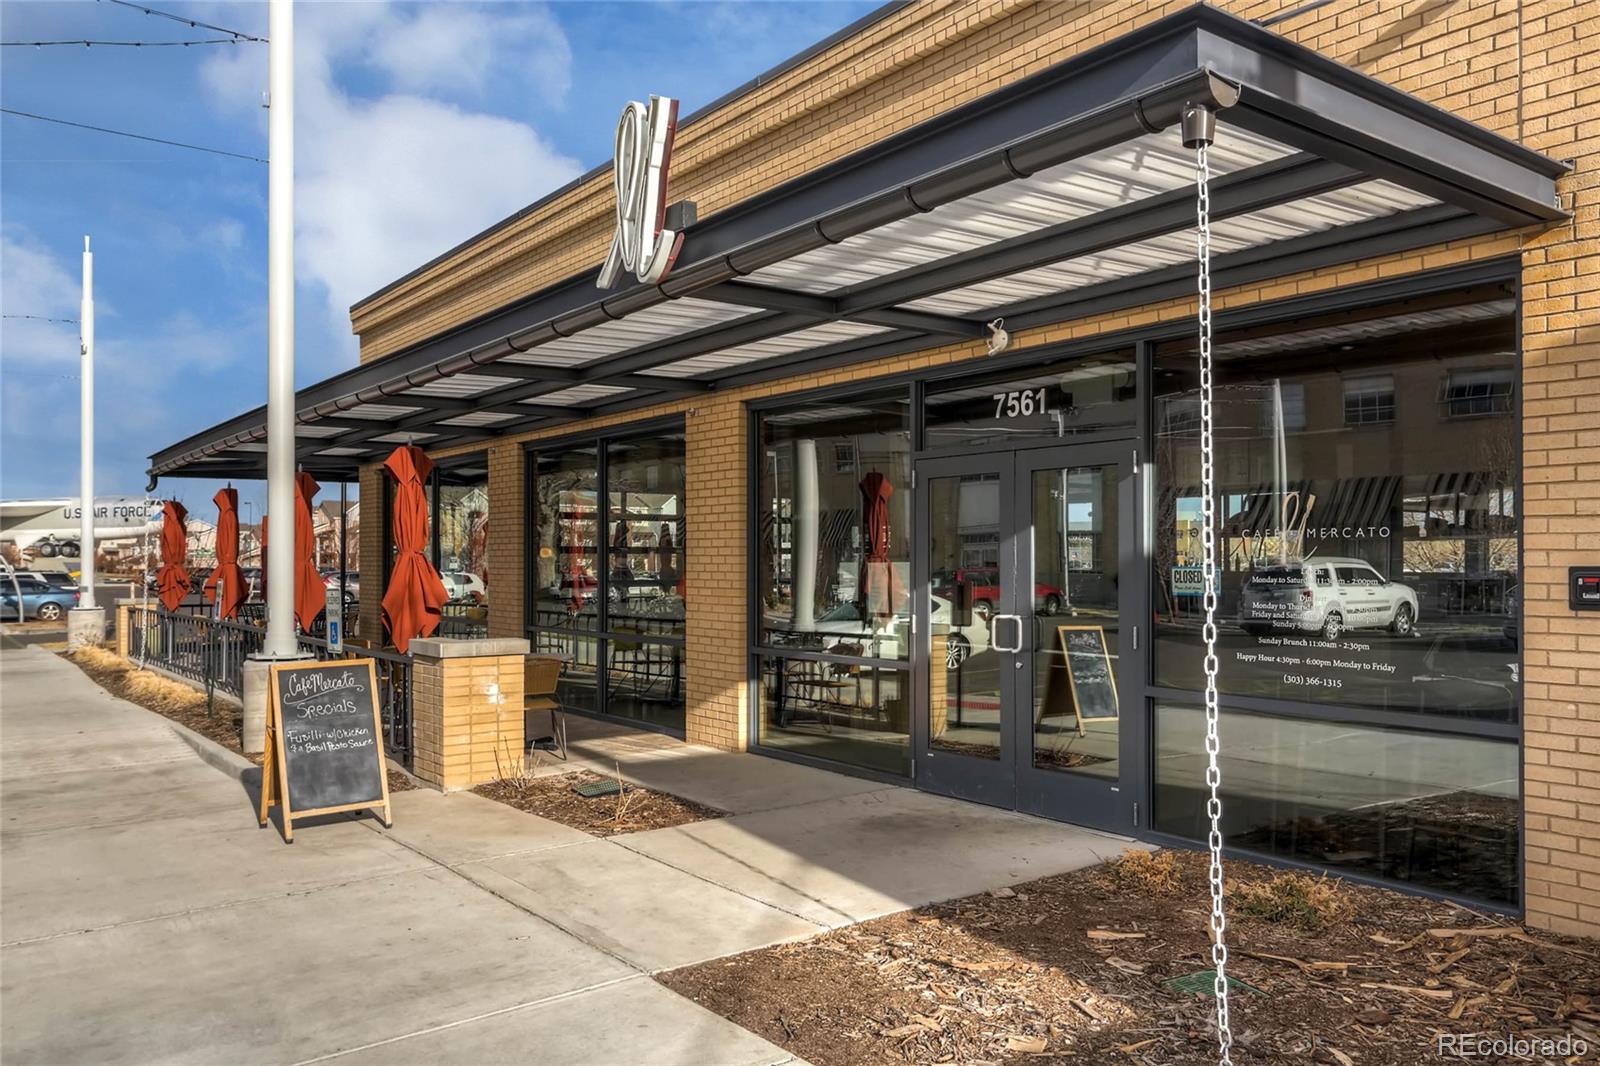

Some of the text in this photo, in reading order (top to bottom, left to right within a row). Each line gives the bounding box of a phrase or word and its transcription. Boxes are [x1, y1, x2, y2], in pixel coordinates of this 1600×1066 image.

[993, 388, 1045, 419] 7561
[64, 508, 82, 519] U.S
[113, 505, 152, 518] FORCE
[1306, 526, 1390, 539] MERCATO
[1174, 570, 1203, 584] CLOSED
[1252, 576, 1277, 585] Monday
[1287, 577, 1313, 586] Saturd
[1252, 602, 1278, 612] Monday
[1251, 610, 1271, 620] Friday
[1272, 620, 1296, 630] Sunday
[1258, 637, 1282, 646] Sunday
[1283, 638, 1308, 646] Brunch
[1309, 640, 1337, 648] 11:00am
[1343, 643, 1370, 651] 2:30pm
[1236, 652, 1257, 662] Happy
[1276, 656, 1300, 665] 4:30pm
[1306, 658, 1331, 667] 6:00pm
[1333, 660, 1362, 670] Monday
[1372, 663, 1396, 673] Friday
[289, 671, 354, 697] Café Mercato
[1283, 675, 1342, 688] (303) 366-1315
[297, 700, 356, 719] Specials
